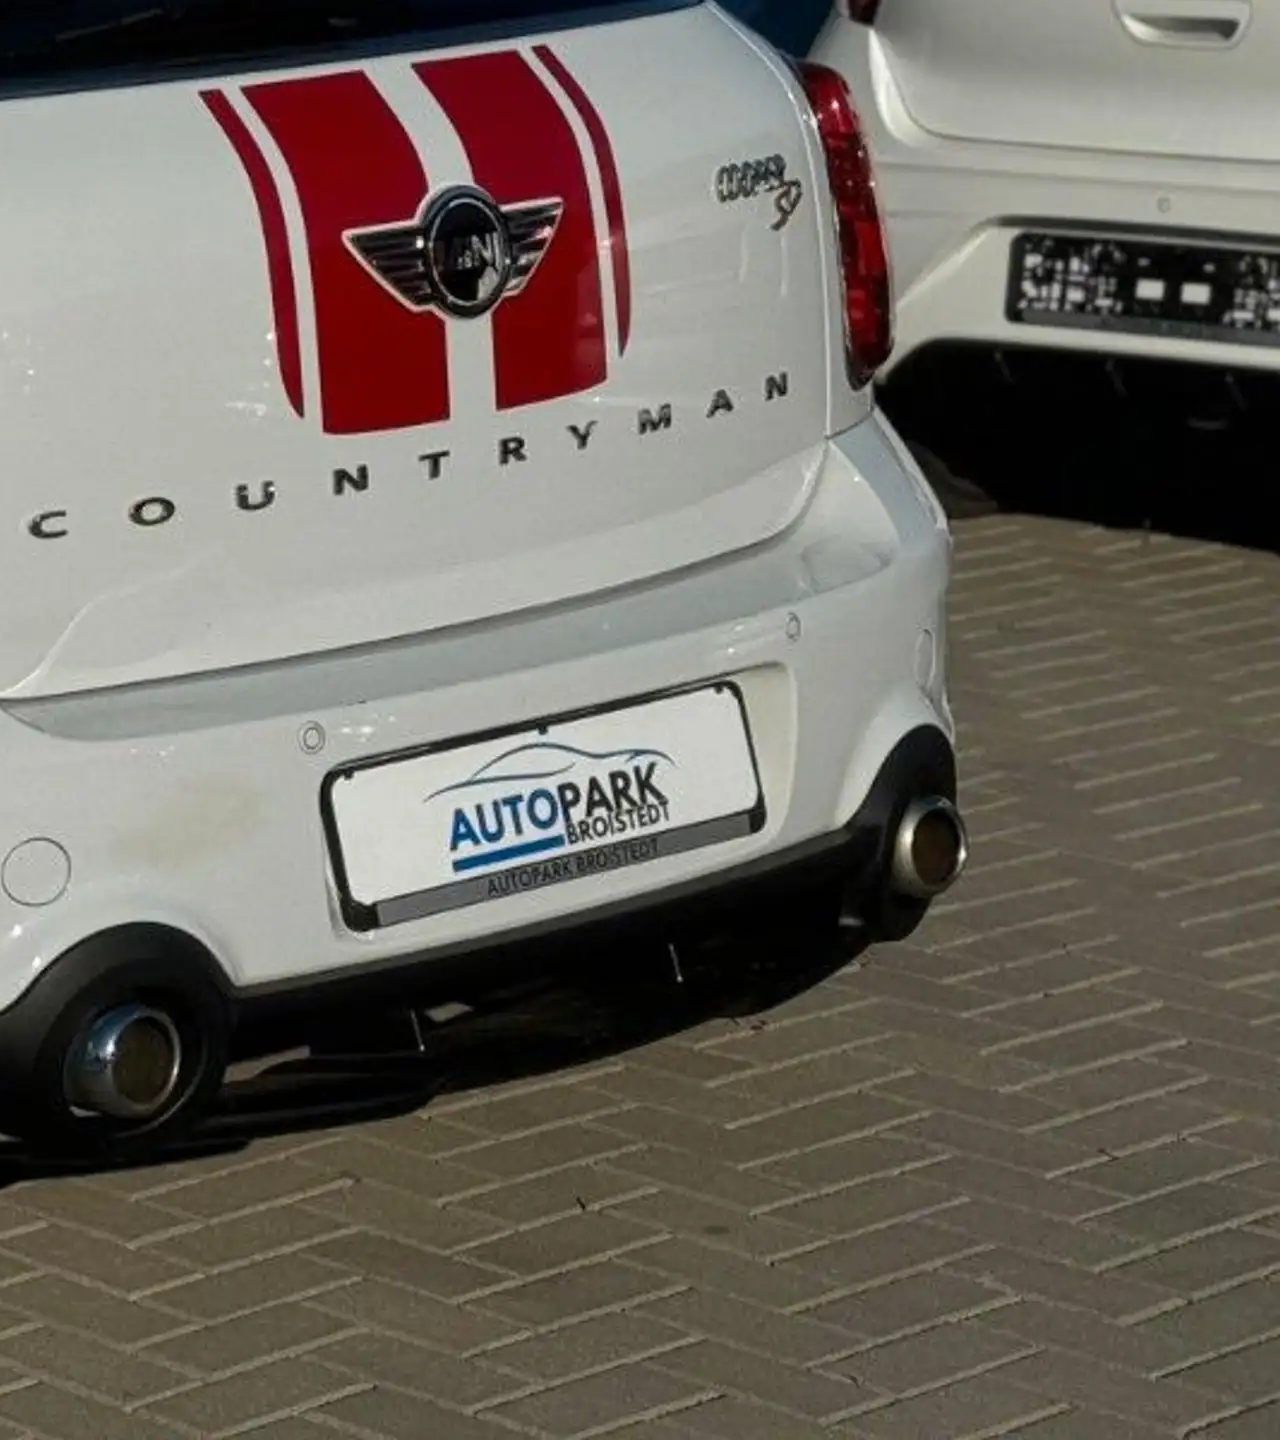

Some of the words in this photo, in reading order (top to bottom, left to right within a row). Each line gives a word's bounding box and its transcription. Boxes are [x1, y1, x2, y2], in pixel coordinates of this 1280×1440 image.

[26, 372, 791, 541] COUNTRYMAN
[450, 762, 669, 851] AUTOPARK
[567, 803, 671, 845] BROISTEDT
